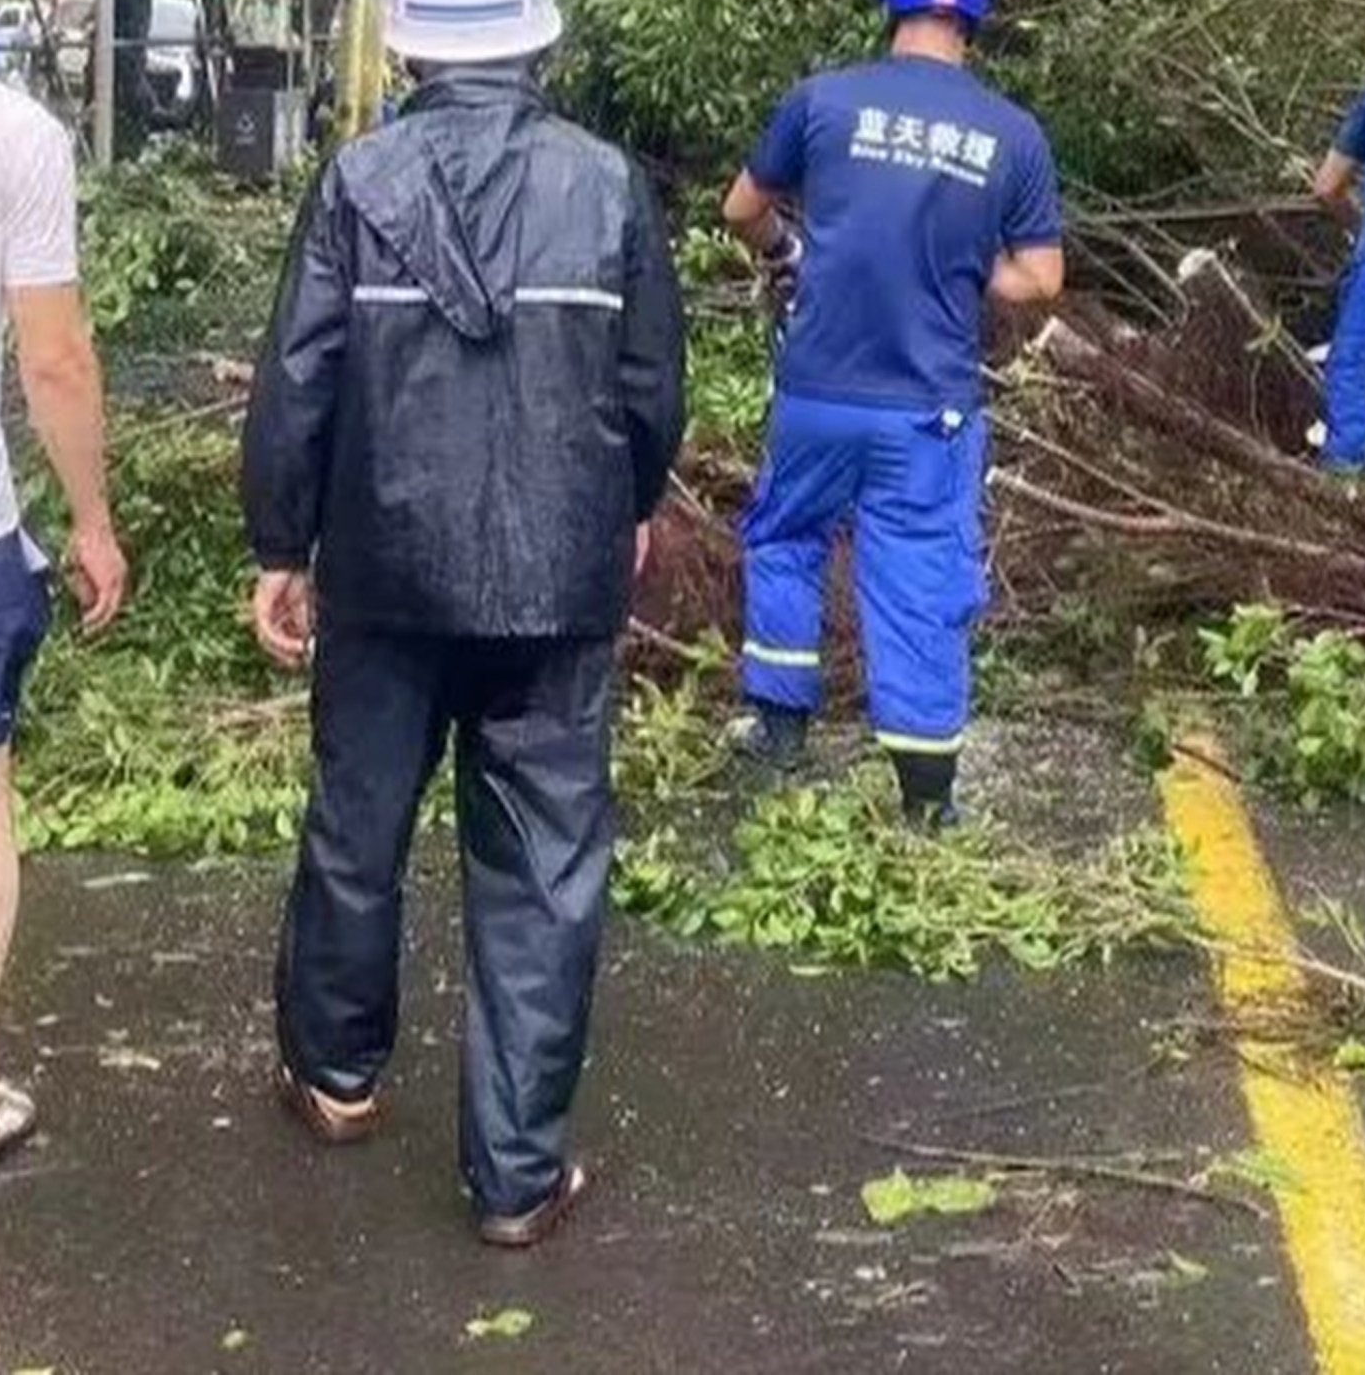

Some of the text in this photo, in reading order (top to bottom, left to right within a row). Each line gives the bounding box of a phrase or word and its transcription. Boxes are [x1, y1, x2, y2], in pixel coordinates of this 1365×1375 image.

[849, 141, 888, 163] Blue
[892, 148, 926, 169] Sky
[853, 106, 998, 171] 蓝天救援
